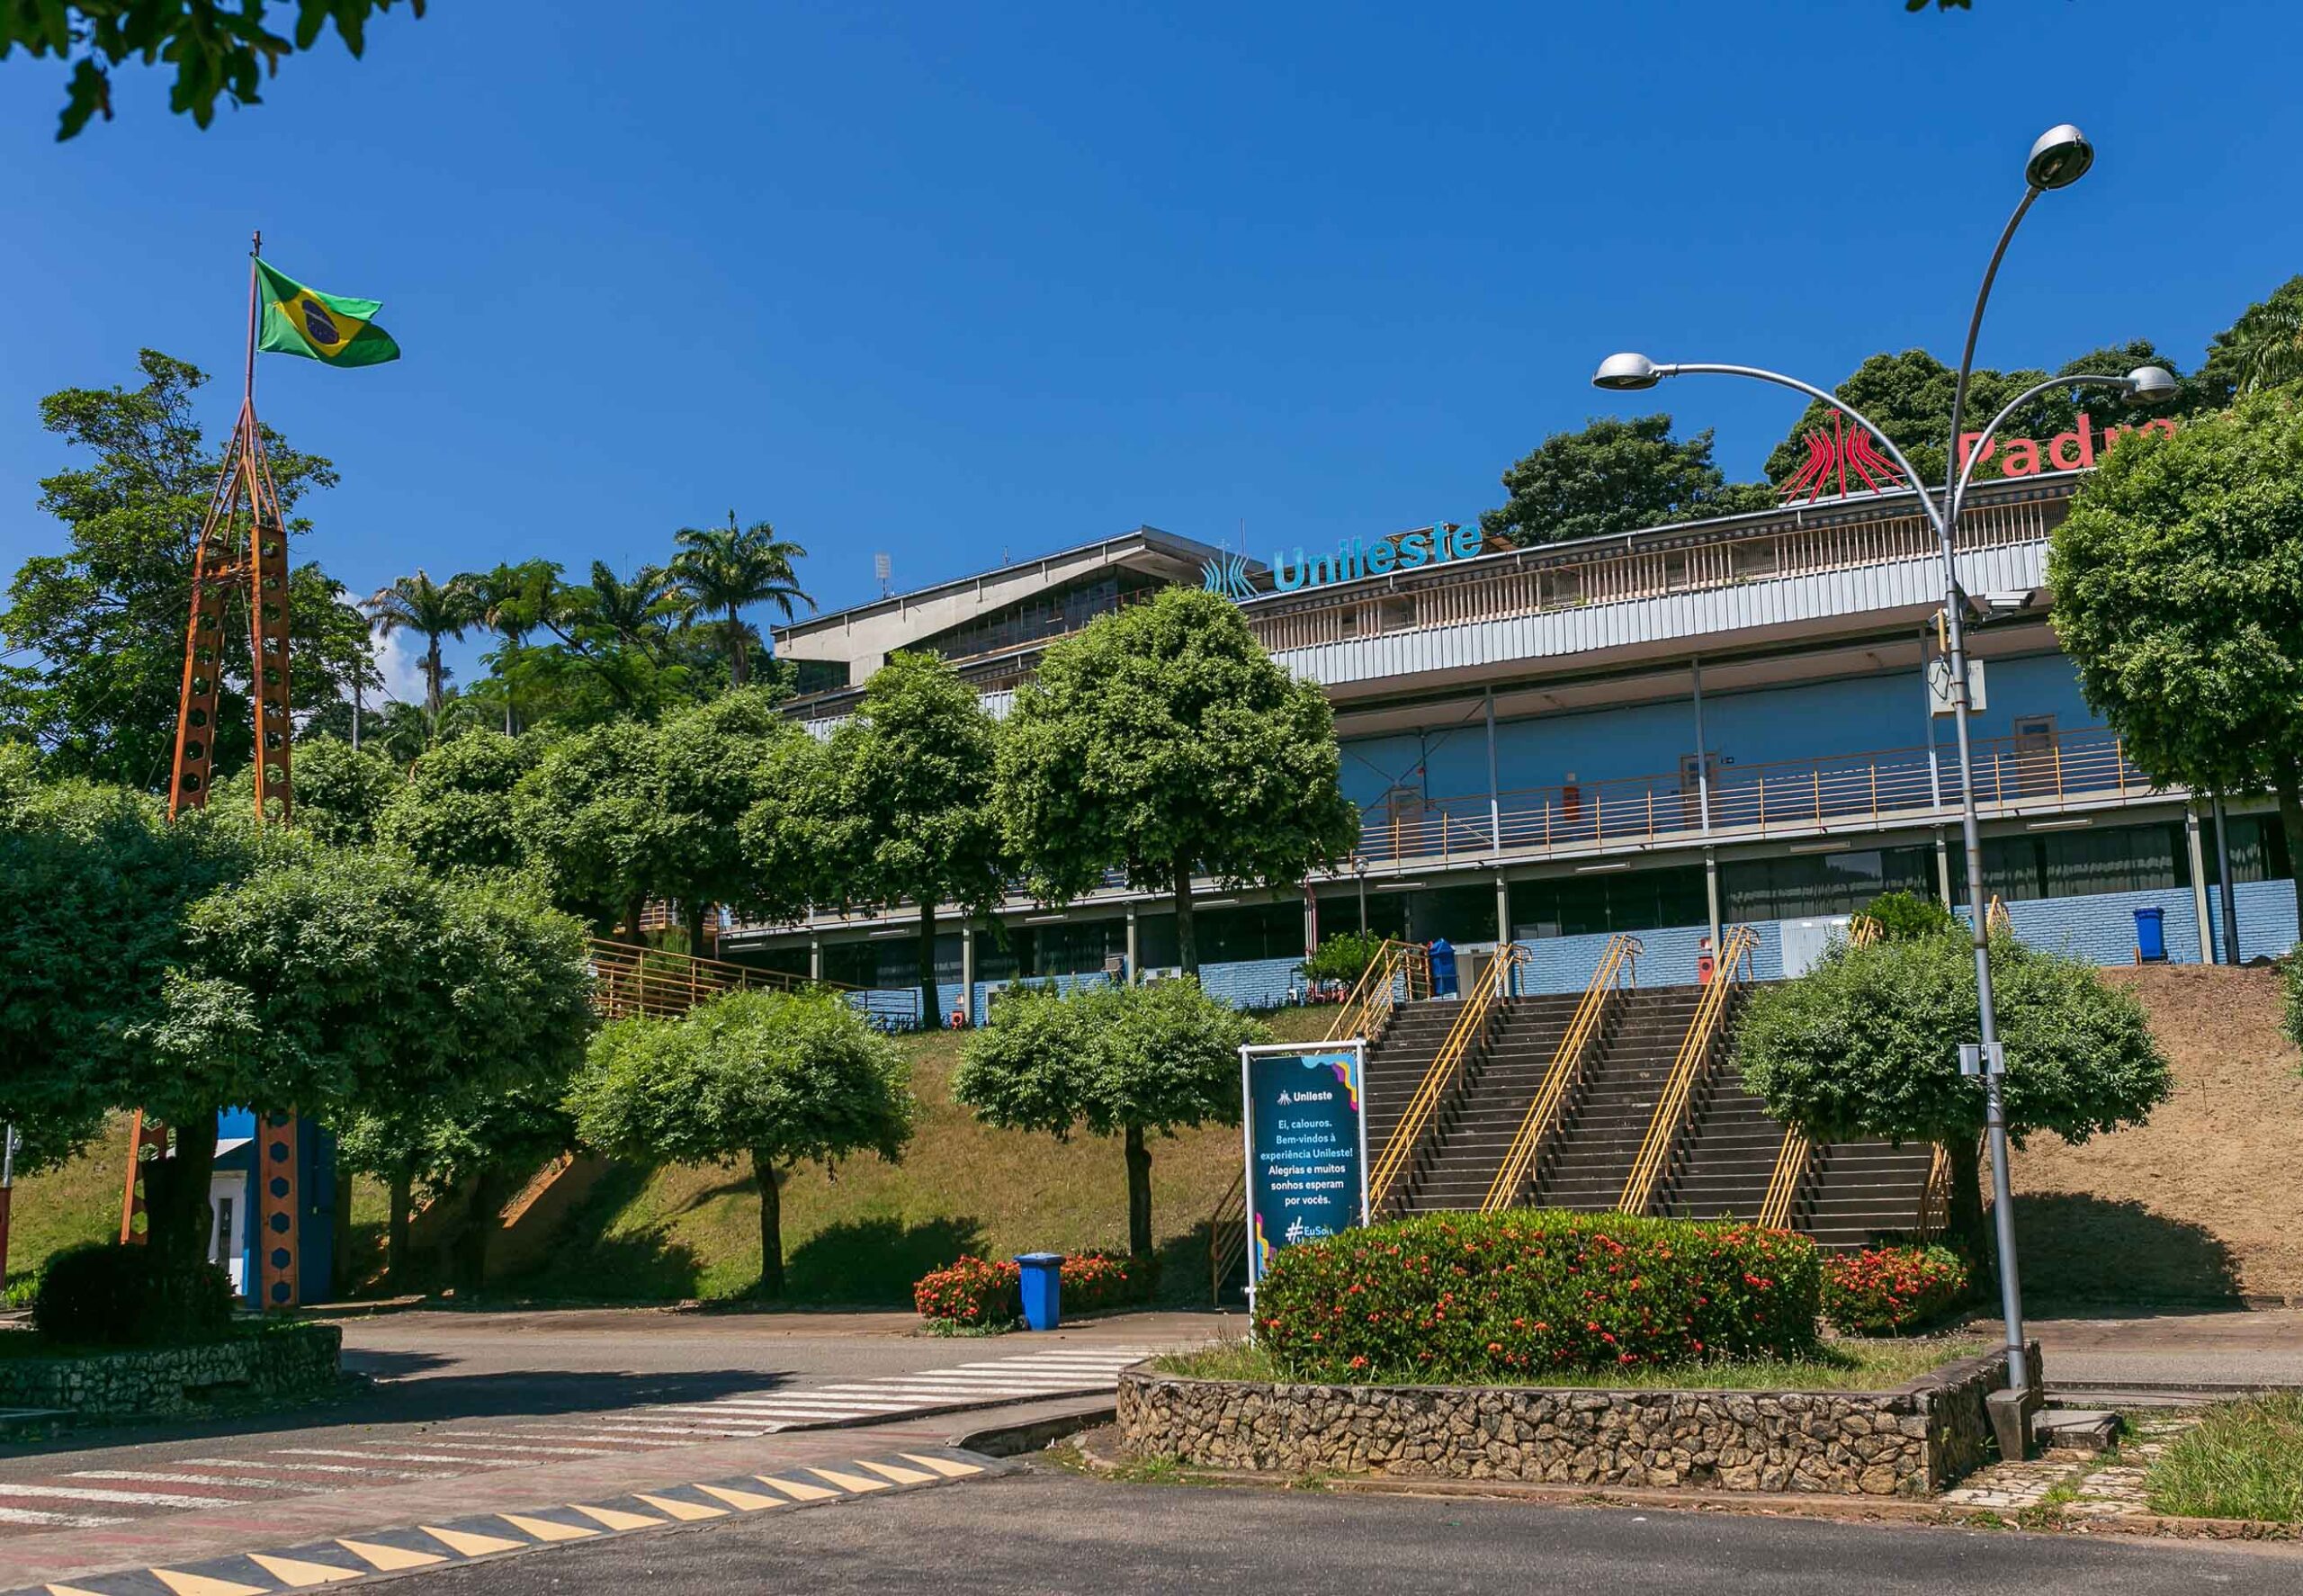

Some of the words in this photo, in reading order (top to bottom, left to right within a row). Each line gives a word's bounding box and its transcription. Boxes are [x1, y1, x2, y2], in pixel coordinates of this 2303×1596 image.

[1274, 520, 1483, 592] Unileste
[1293, 1091, 1333, 1102] Unileste
[1278, 1119, 1289, 1130] Ei,
[1291, 1118, 1332, 1129] calouros.
[1276, 1134, 1329, 1144] Bem-vindos
[1330, 1133, 1337, 1143] à
[1260, 1149, 1311, 1162] experiência
[1313, 1148, 1353, 1159] Unileste!
[1268, 1165, 1304, 1178] Alegrias
[1313, 1164, 1346, 1174] muitos
[1270, 1179, 1304, 1190] sonhos
[1304, 1180, 1345, 1191] esperam
[1285, 1197, 1300, 1207] por
[1302, 1194, 1331, 1205] vocês.
